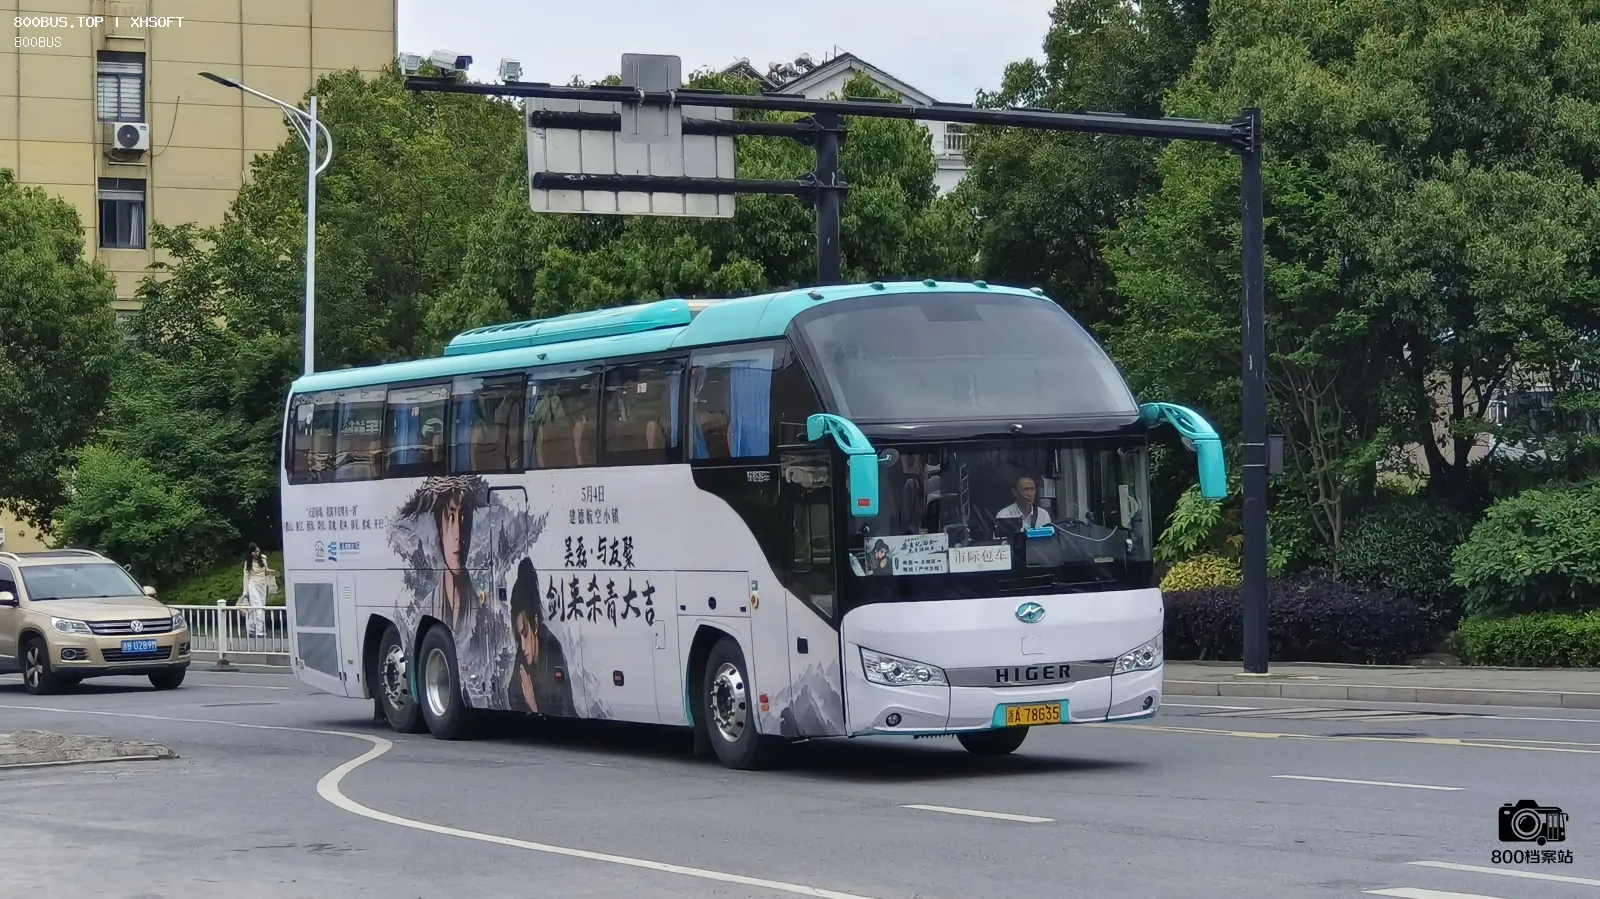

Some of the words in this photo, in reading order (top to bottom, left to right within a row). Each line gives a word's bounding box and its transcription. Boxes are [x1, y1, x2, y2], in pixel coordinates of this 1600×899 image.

[581, 485, 605, 502] 5月4日
[569, 508, 620, 525] 建德航空小镇
[954, 549, 1007, 565] 市际包车
[546, 573, 656, 628] 剑来杀青大吉
[995, 665, 1071, 683] HIGER
